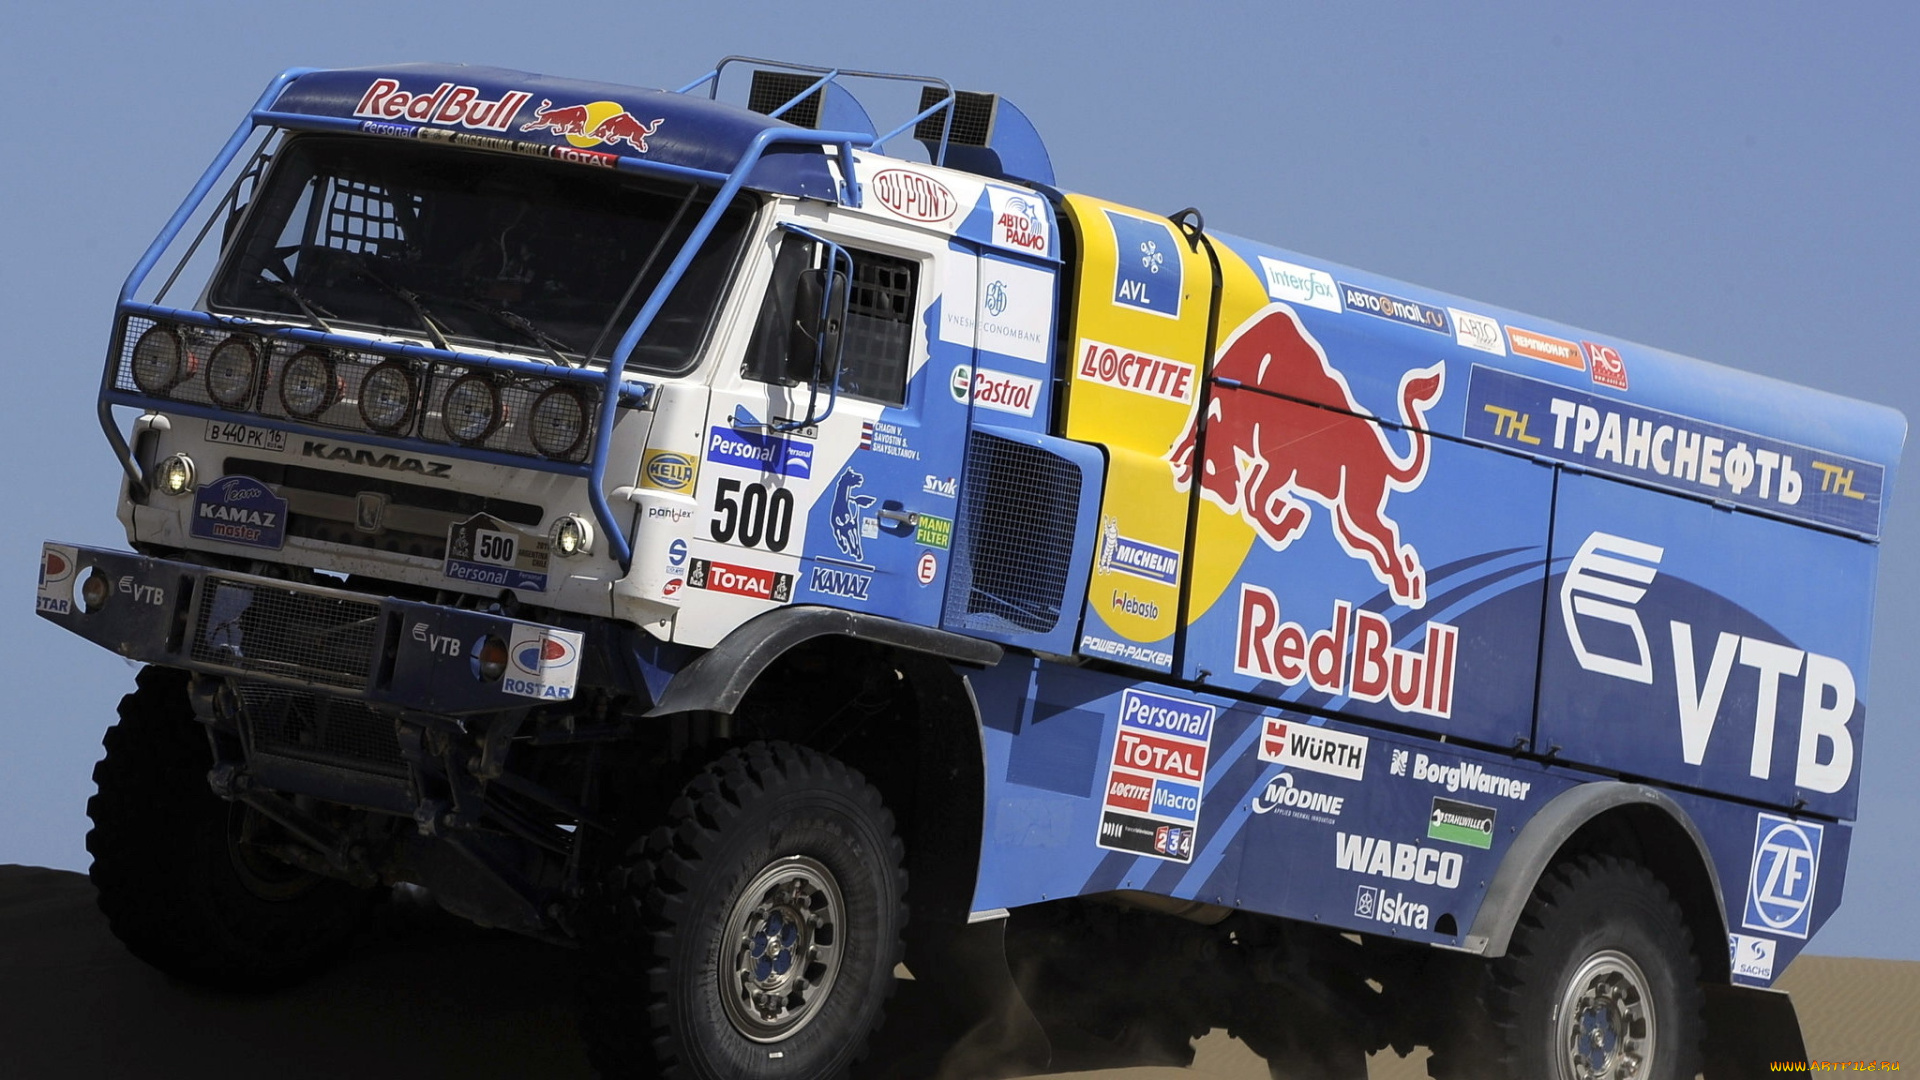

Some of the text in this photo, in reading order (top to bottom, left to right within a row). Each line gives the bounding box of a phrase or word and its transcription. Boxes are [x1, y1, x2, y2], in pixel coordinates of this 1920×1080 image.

[362, 121, 416, 138] Personal
[557, 146, 614, 168] TOTAL
[1119, 279, 1150, 303] AVL
[1081, 345, 1192, 399] LOCTITE
[975, 373, 1034, 410] Castrol
[302, 441, 452, 478] KAMAZ
[710, 434, 776, 462] Personal
[1550, 397, 1803, 506] ТРАНСНЕФТЬ
[650, 463, 693, 482] HELLA
[200, 503, 276, 528] KAMAZ
[710, 477, 795, 553] 500
[919, 516, 951, 534] MANN
[213, 523, 261, 540] master
[917, 529, 948, 547] FILTER
[480, 534, 514, 562] 500
[1116, 545, 1177, 575] MICHELIN
[449, 562, 509, 584] Personal
[711, 567, 770, 594] TOTAL
[809, 567, 871, 601] KAMAZ
[921, 559, 933, 579] E
[133, 585, 164, 606] VTB
[1112, 589, 1158, 619] Webasto
[429, 633, 461, 657] VTB
[504, 678, 571, 699] ROSTAR
[1124, 696, 1210, 736] Personal
[1670, 620, 1856, 794] VTB
[1121, 734, 1199, 776] TOTAL
[1413, 753, 1531, 800] BorgWarner
[1109, 781, 1196, 812] LOCTITE Macro
[1264, 783, 1344, 816] MODINE
[1336, 832, 1463, 889] WABCO
[1759, 843, 1811, 909] ZF
[1376, 889, 1429, 930] Iskra
[1740, 964, 1771, 977] SACHS
